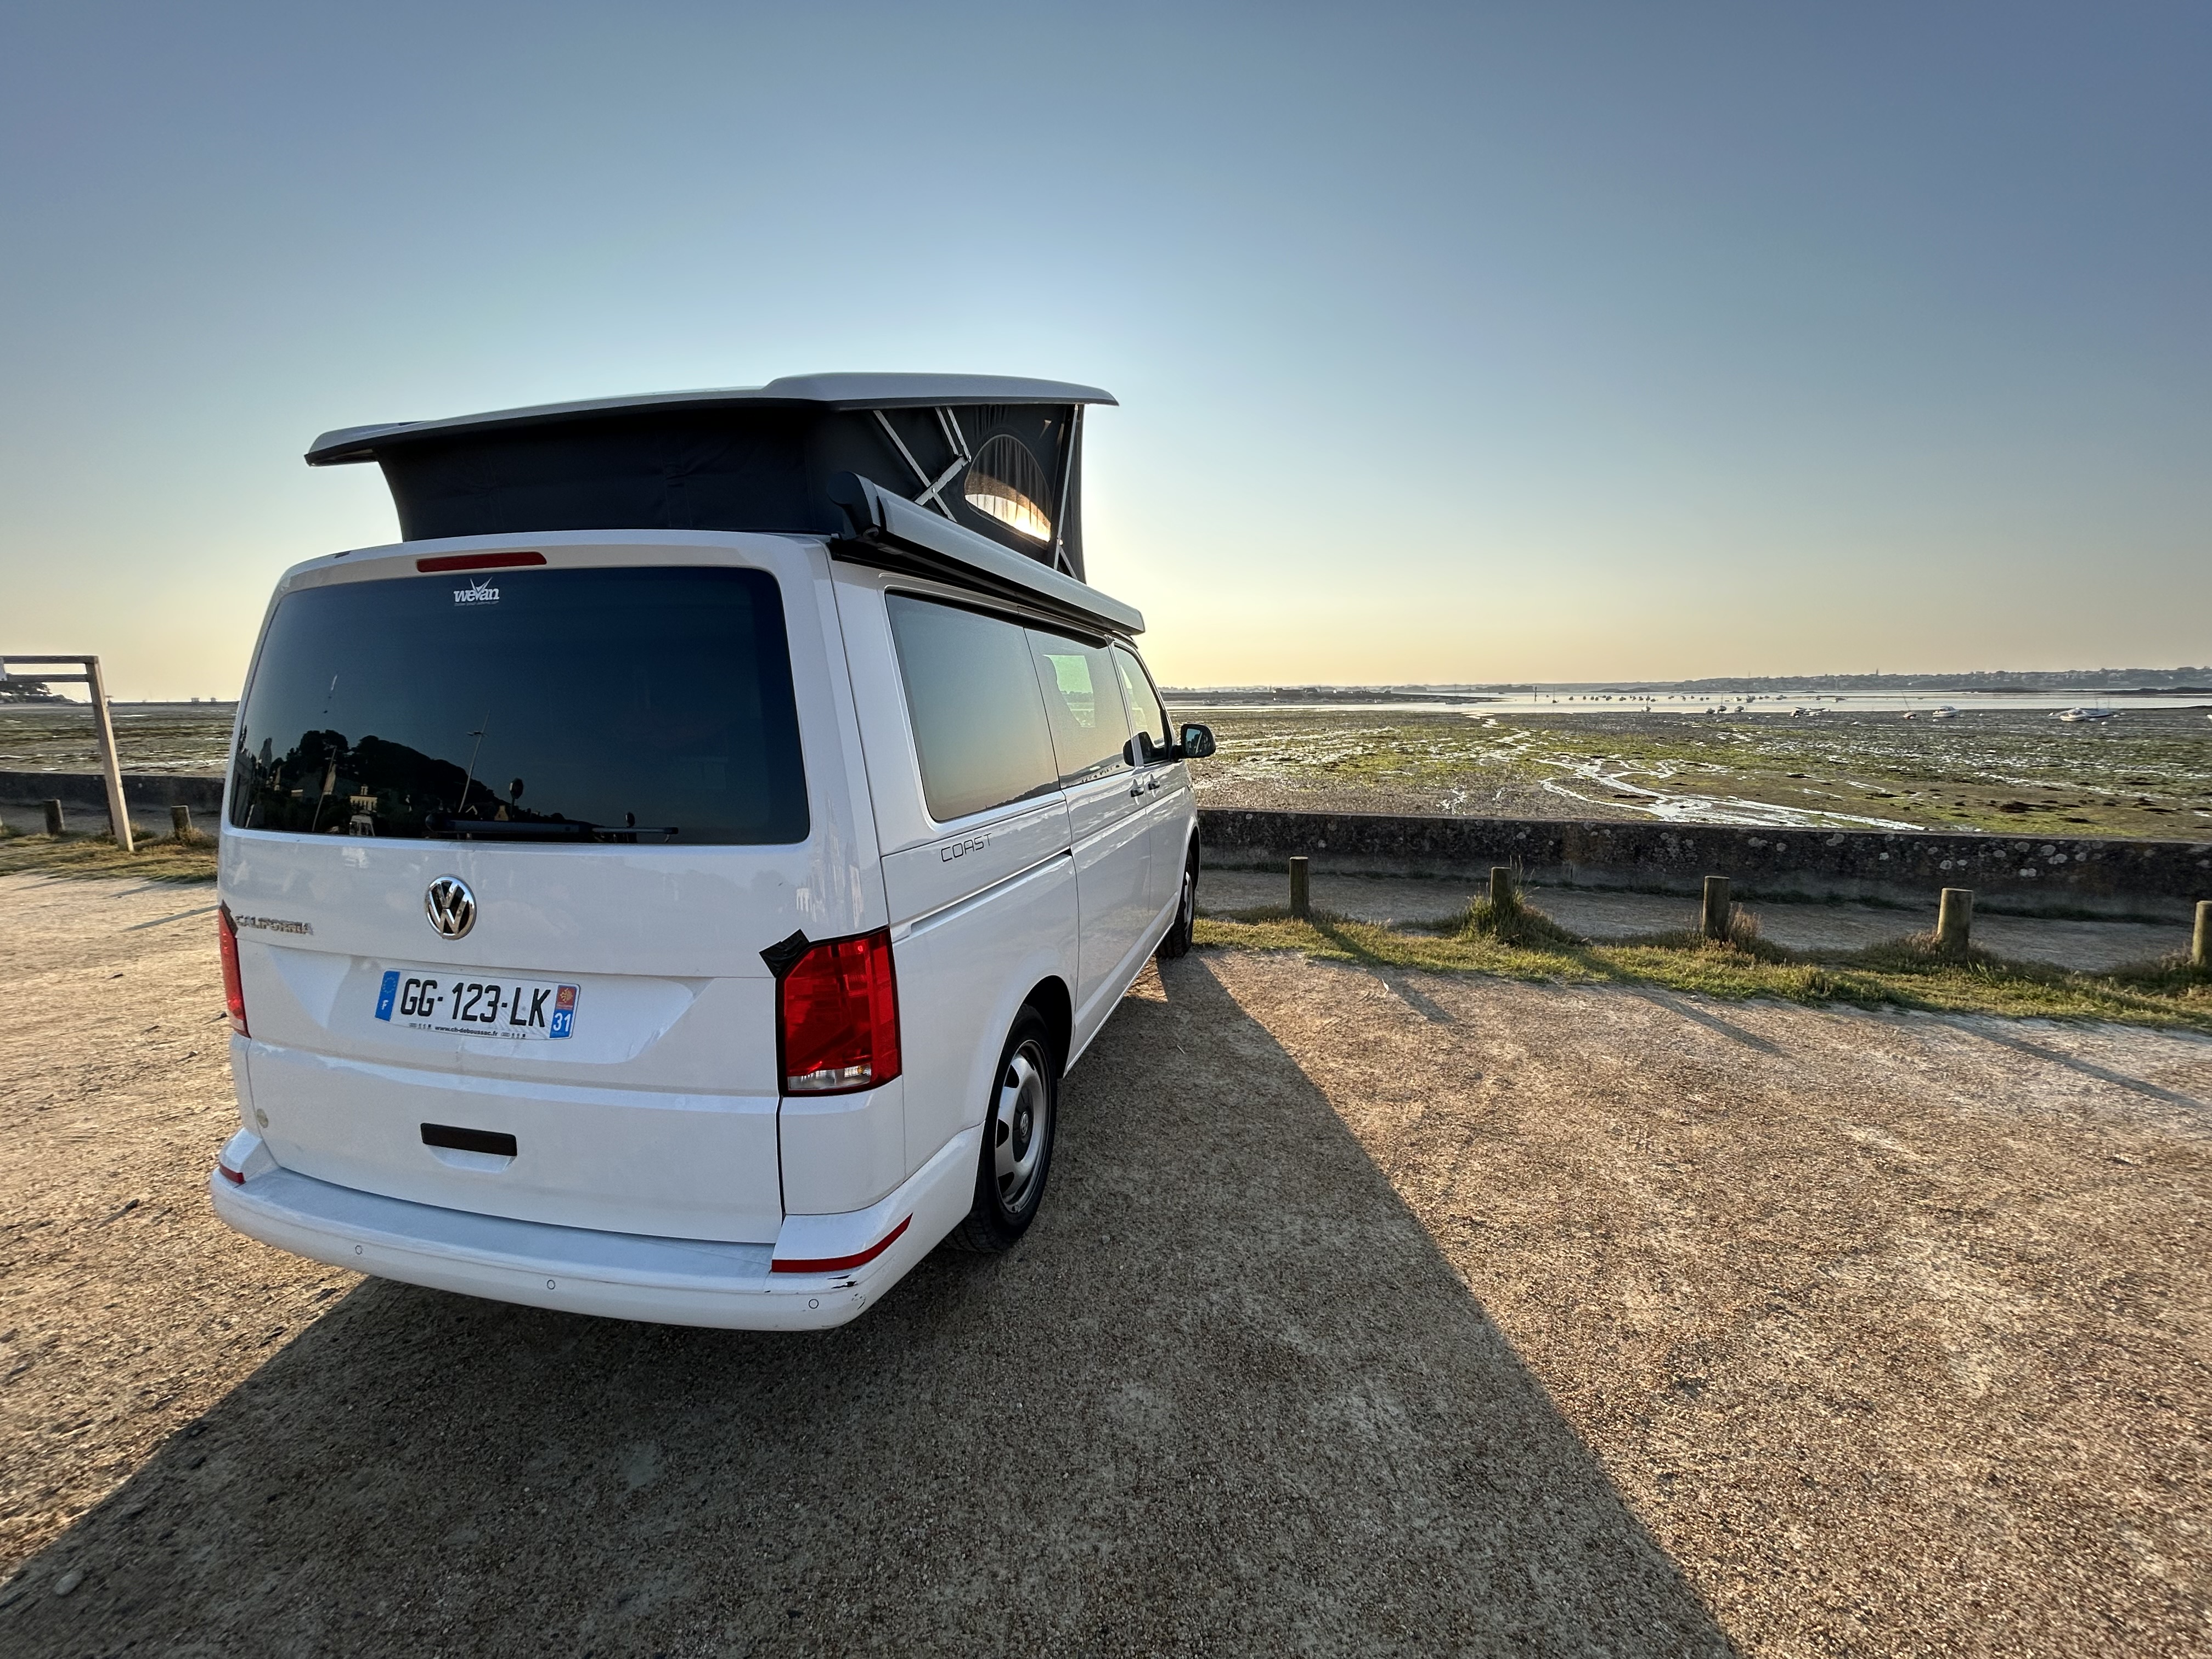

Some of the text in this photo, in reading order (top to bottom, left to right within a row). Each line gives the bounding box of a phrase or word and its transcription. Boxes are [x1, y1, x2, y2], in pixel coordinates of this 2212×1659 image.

[941, 833, 991, 862] COAST
[381, 1000, 389, 1010] F
[553, 1013, 571, 1031] 31
